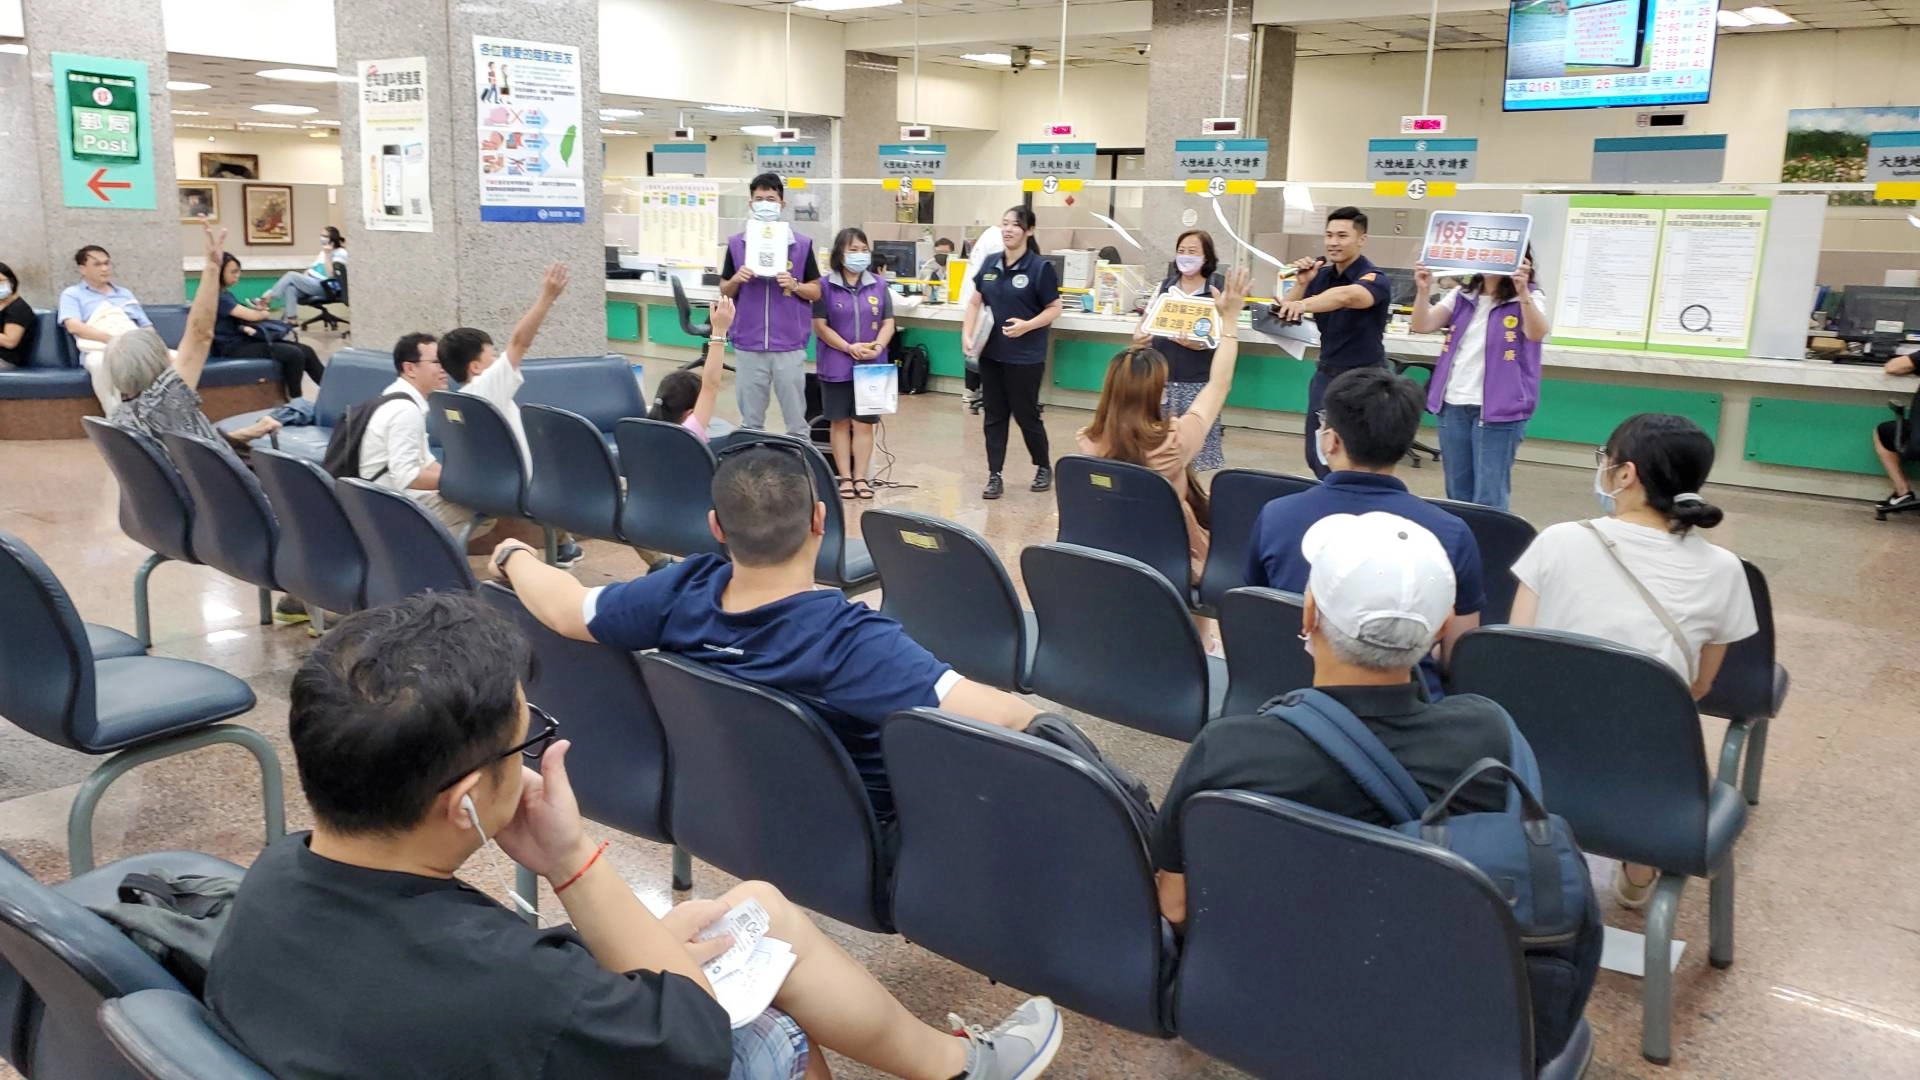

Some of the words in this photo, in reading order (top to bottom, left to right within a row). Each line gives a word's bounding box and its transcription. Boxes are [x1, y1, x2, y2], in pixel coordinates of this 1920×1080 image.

[79, 111, 130, 134] 郵局
[82, 134, 129, 153] Post
[1044, 179, 1058, 189] 47
[1209, 181, 1225, 191] 46
[1408, 183, 1427, 195] 45
